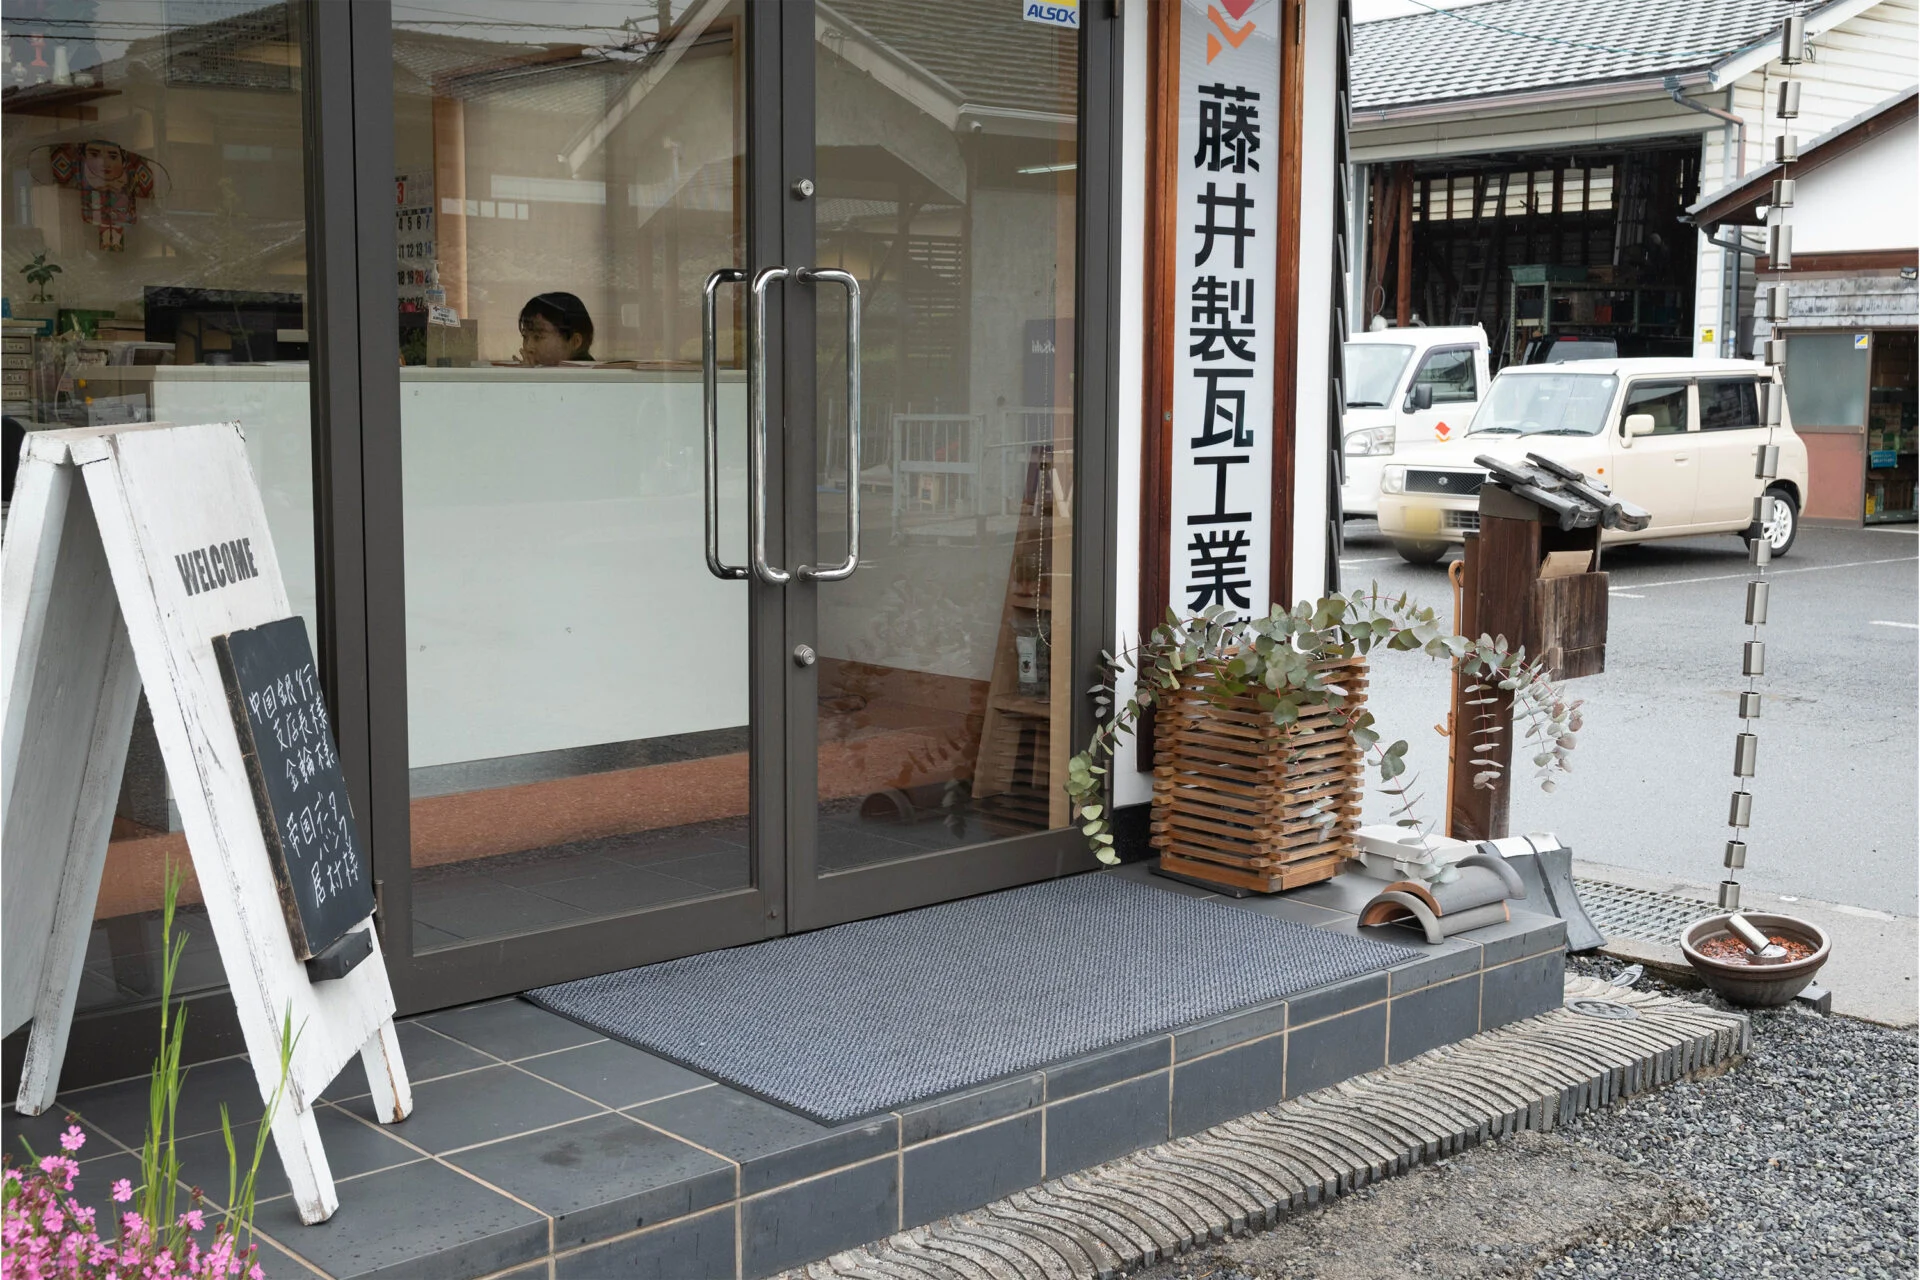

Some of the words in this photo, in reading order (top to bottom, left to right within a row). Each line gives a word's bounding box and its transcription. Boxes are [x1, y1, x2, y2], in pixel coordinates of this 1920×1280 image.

[1027, 4, 1076, 24] ALSOK
[396, 182, 404, 204] 3
[398, 217, 403, 231] 4
[407, 216, 413, 231] 5
[417, 215, 422, 230] 6
[426, 214, 430, 230] 7
[406, 243, 414, 258] 12
[416, 242, 423, 257] 13
[397, 270, 405, 285] 18
[407, 270, 414, 284] 19
[415, 269, 424, 285] 20
[174, 537, 259, 597] WELCOME
